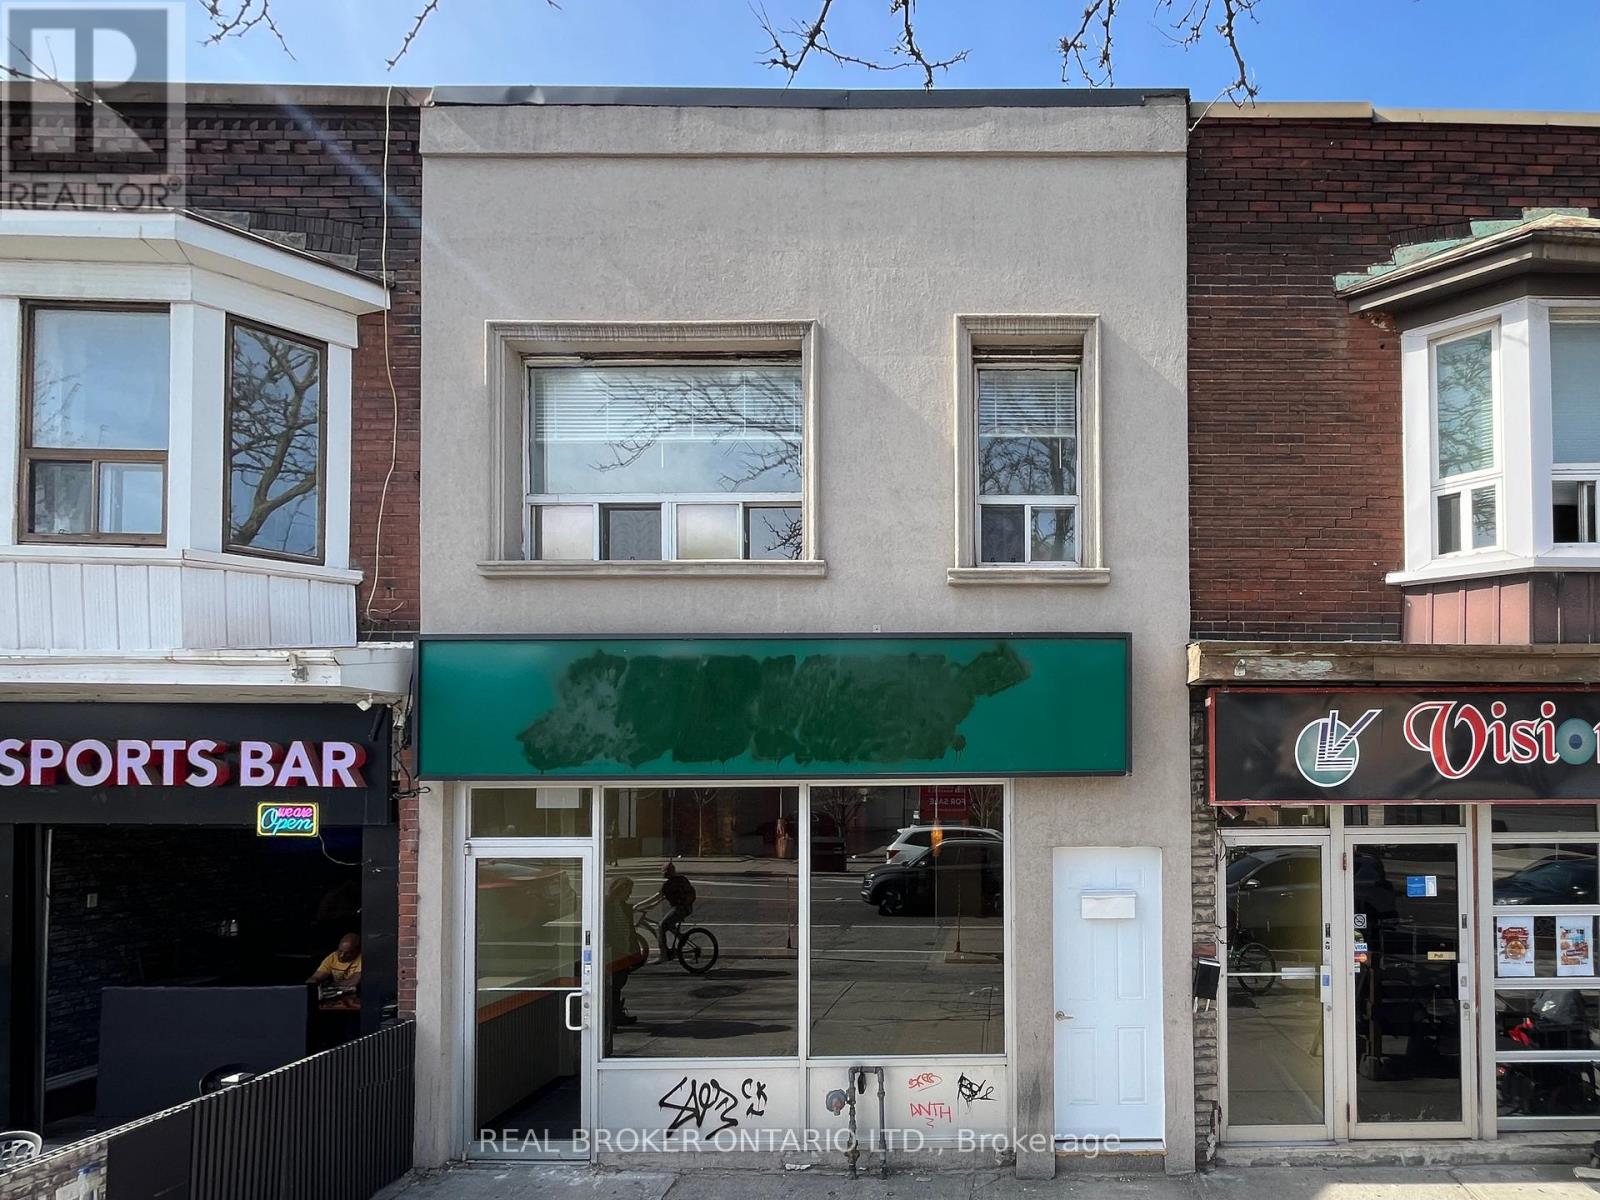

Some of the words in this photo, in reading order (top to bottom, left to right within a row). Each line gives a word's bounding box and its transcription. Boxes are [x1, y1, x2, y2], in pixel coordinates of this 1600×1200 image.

[0, 739, 219, 786] SPORTS
[240, 741, 358, 787] BAR
[261, 808, 314, 835] Open
